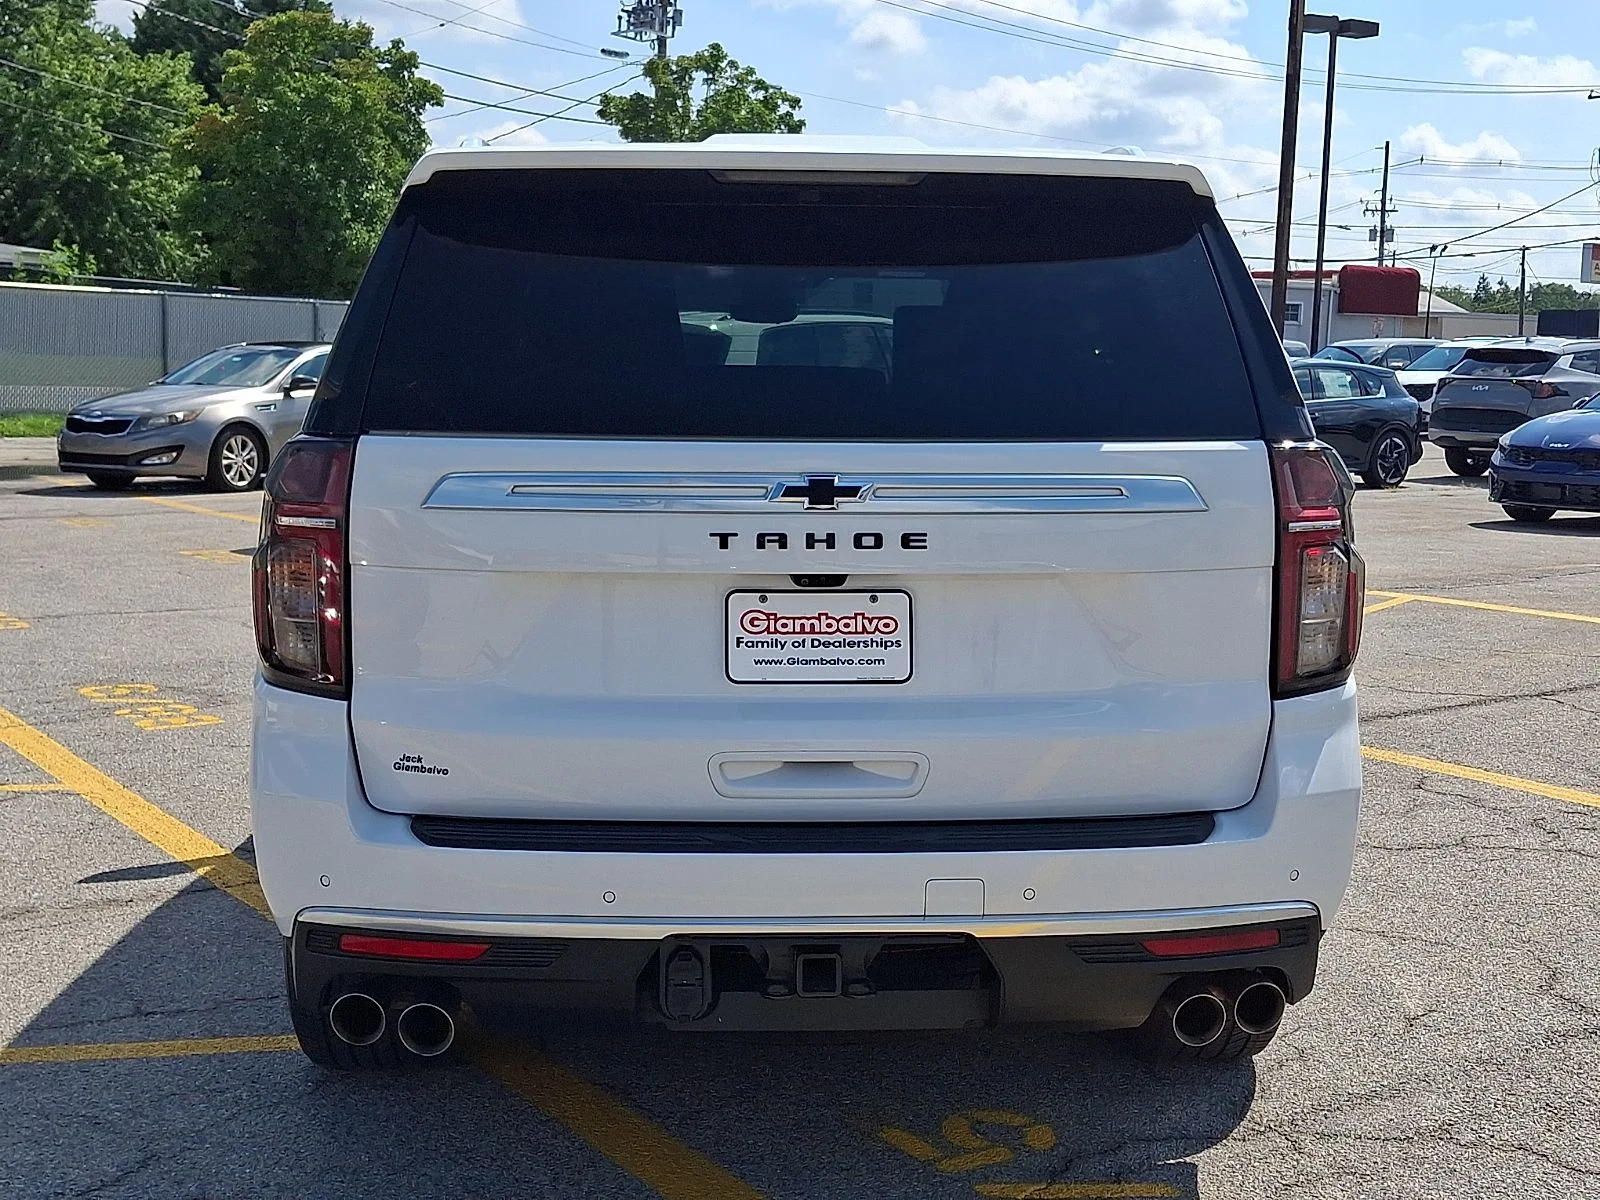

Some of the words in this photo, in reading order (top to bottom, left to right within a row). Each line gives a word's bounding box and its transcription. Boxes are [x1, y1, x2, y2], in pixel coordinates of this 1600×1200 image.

[709, 532, 928, 550] TAHOE
[739, 609, 899, 635] Giambalvo
[736, 636, 788, 651] Family
[791, 637, 806, 649] of
[810, 637, 902, 651] Dealerships
[753, 657, 886, 667] www.Giambalvo.com
[399, 753, 423, 764] Jack
[393, 761, 449, 776] Giambalvo
